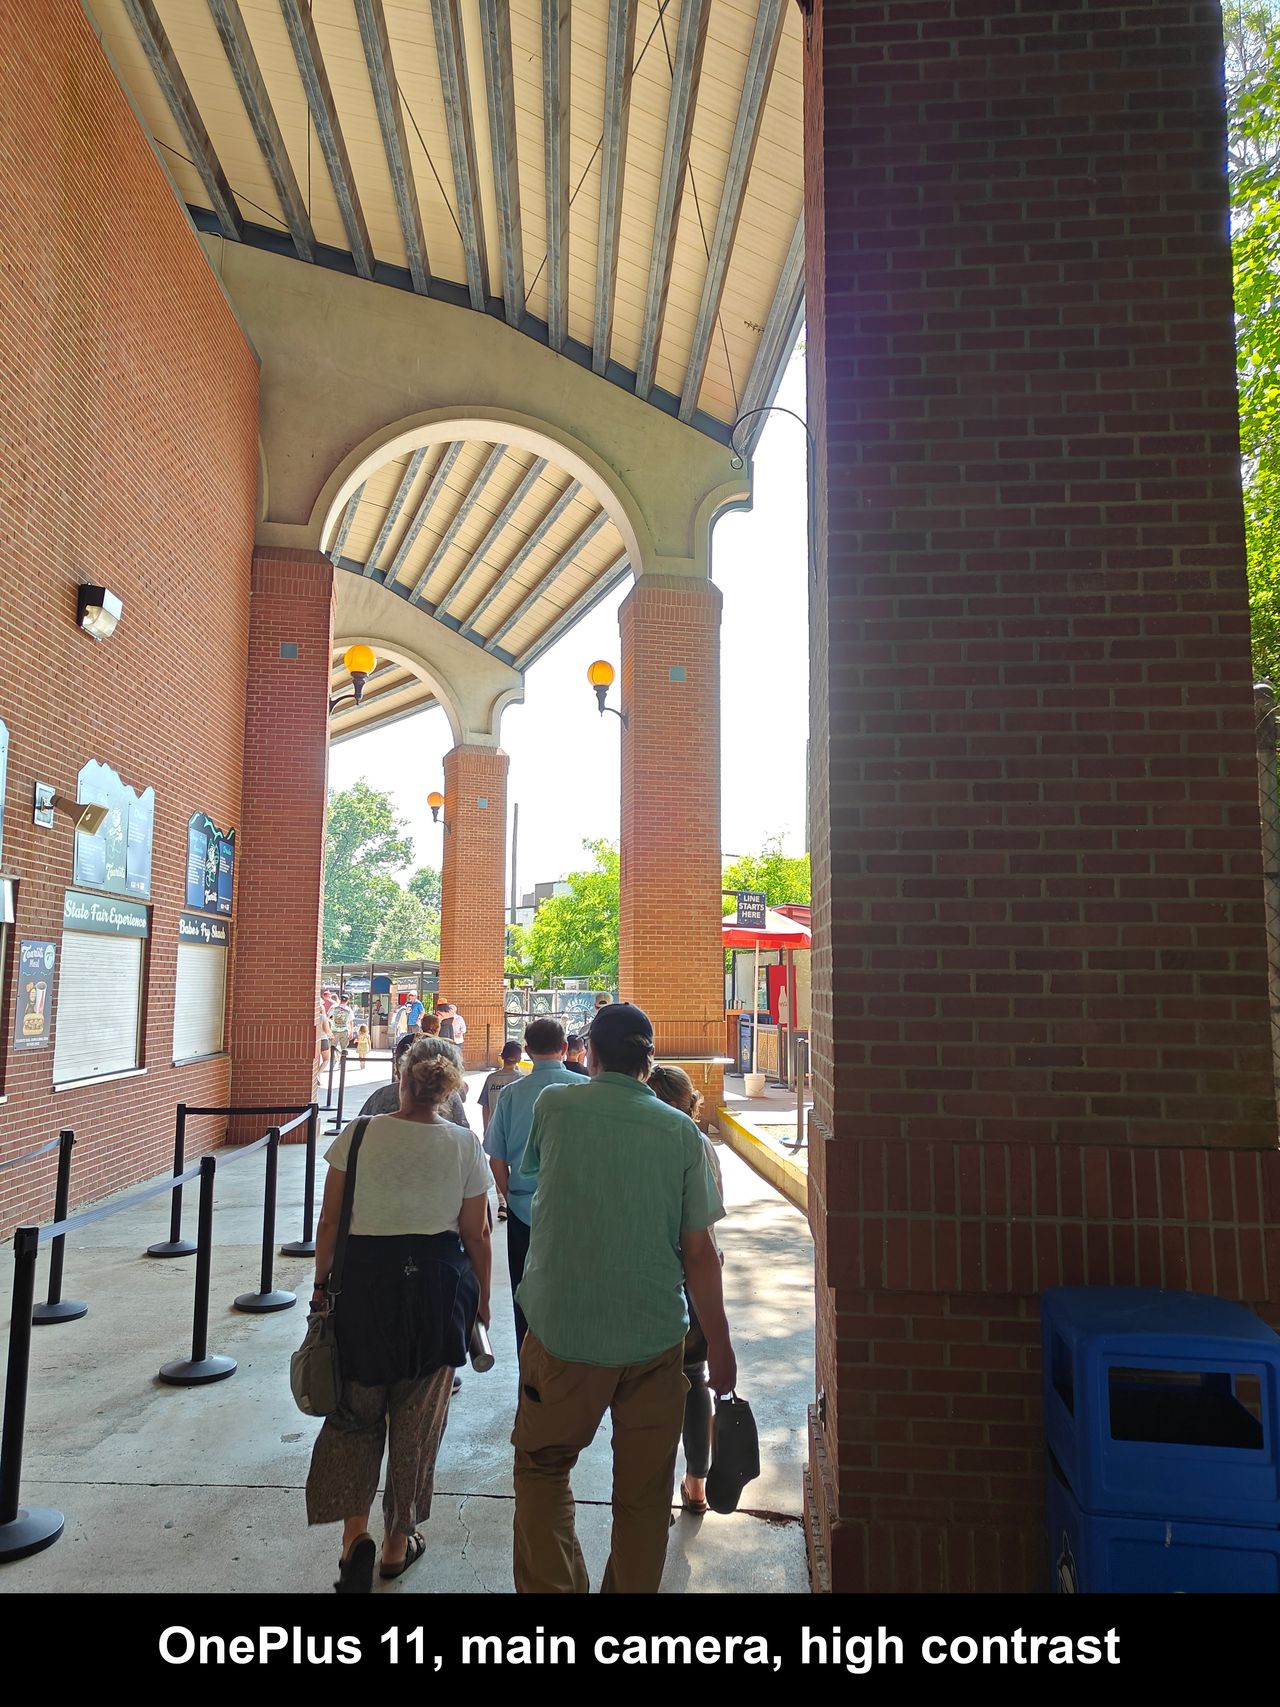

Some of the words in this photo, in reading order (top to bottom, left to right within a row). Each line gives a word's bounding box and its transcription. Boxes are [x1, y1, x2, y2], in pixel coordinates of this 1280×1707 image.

[64, 900, 89, 919] State
[90, 904, 109, 923] Fair
[109, 907, 147, 930] Experience
[200, 922, 210, 942] Fry
